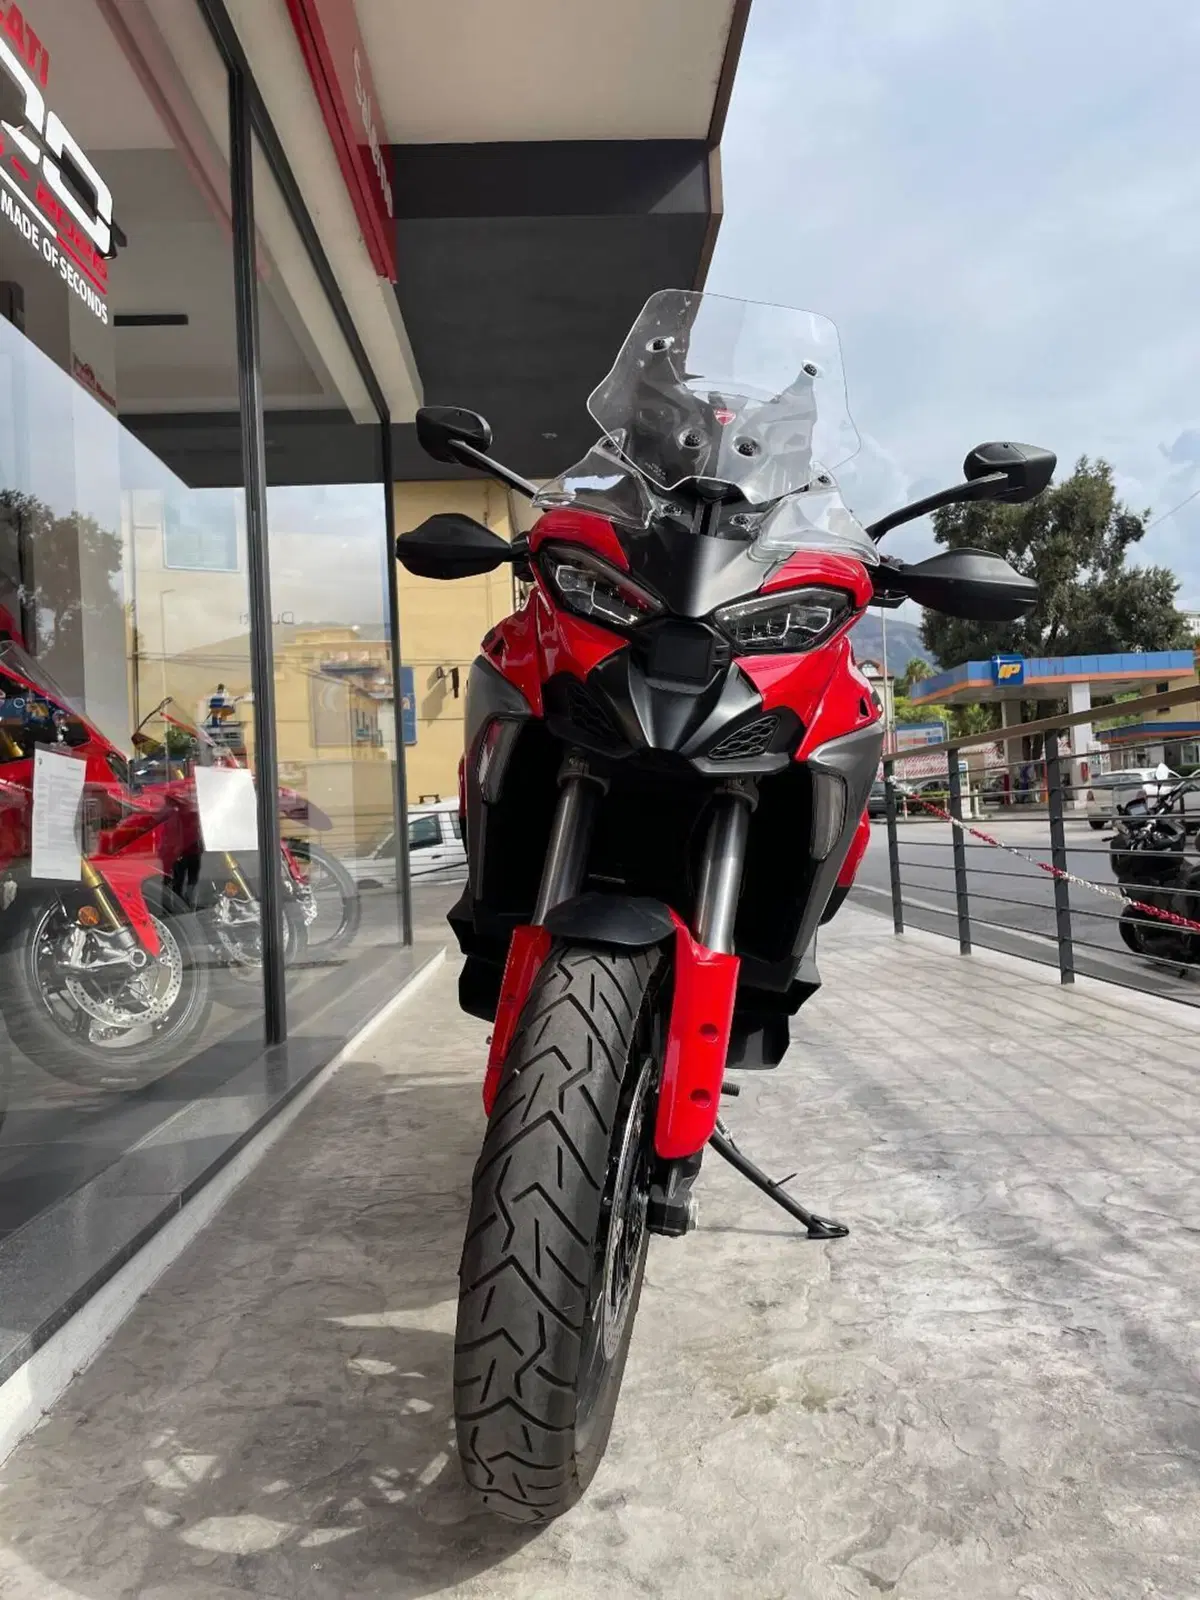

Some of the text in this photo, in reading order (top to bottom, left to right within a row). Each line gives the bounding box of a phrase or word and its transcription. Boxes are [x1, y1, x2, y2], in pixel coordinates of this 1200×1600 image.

[1, 188, 108, 325] MADE OF SECONDS
